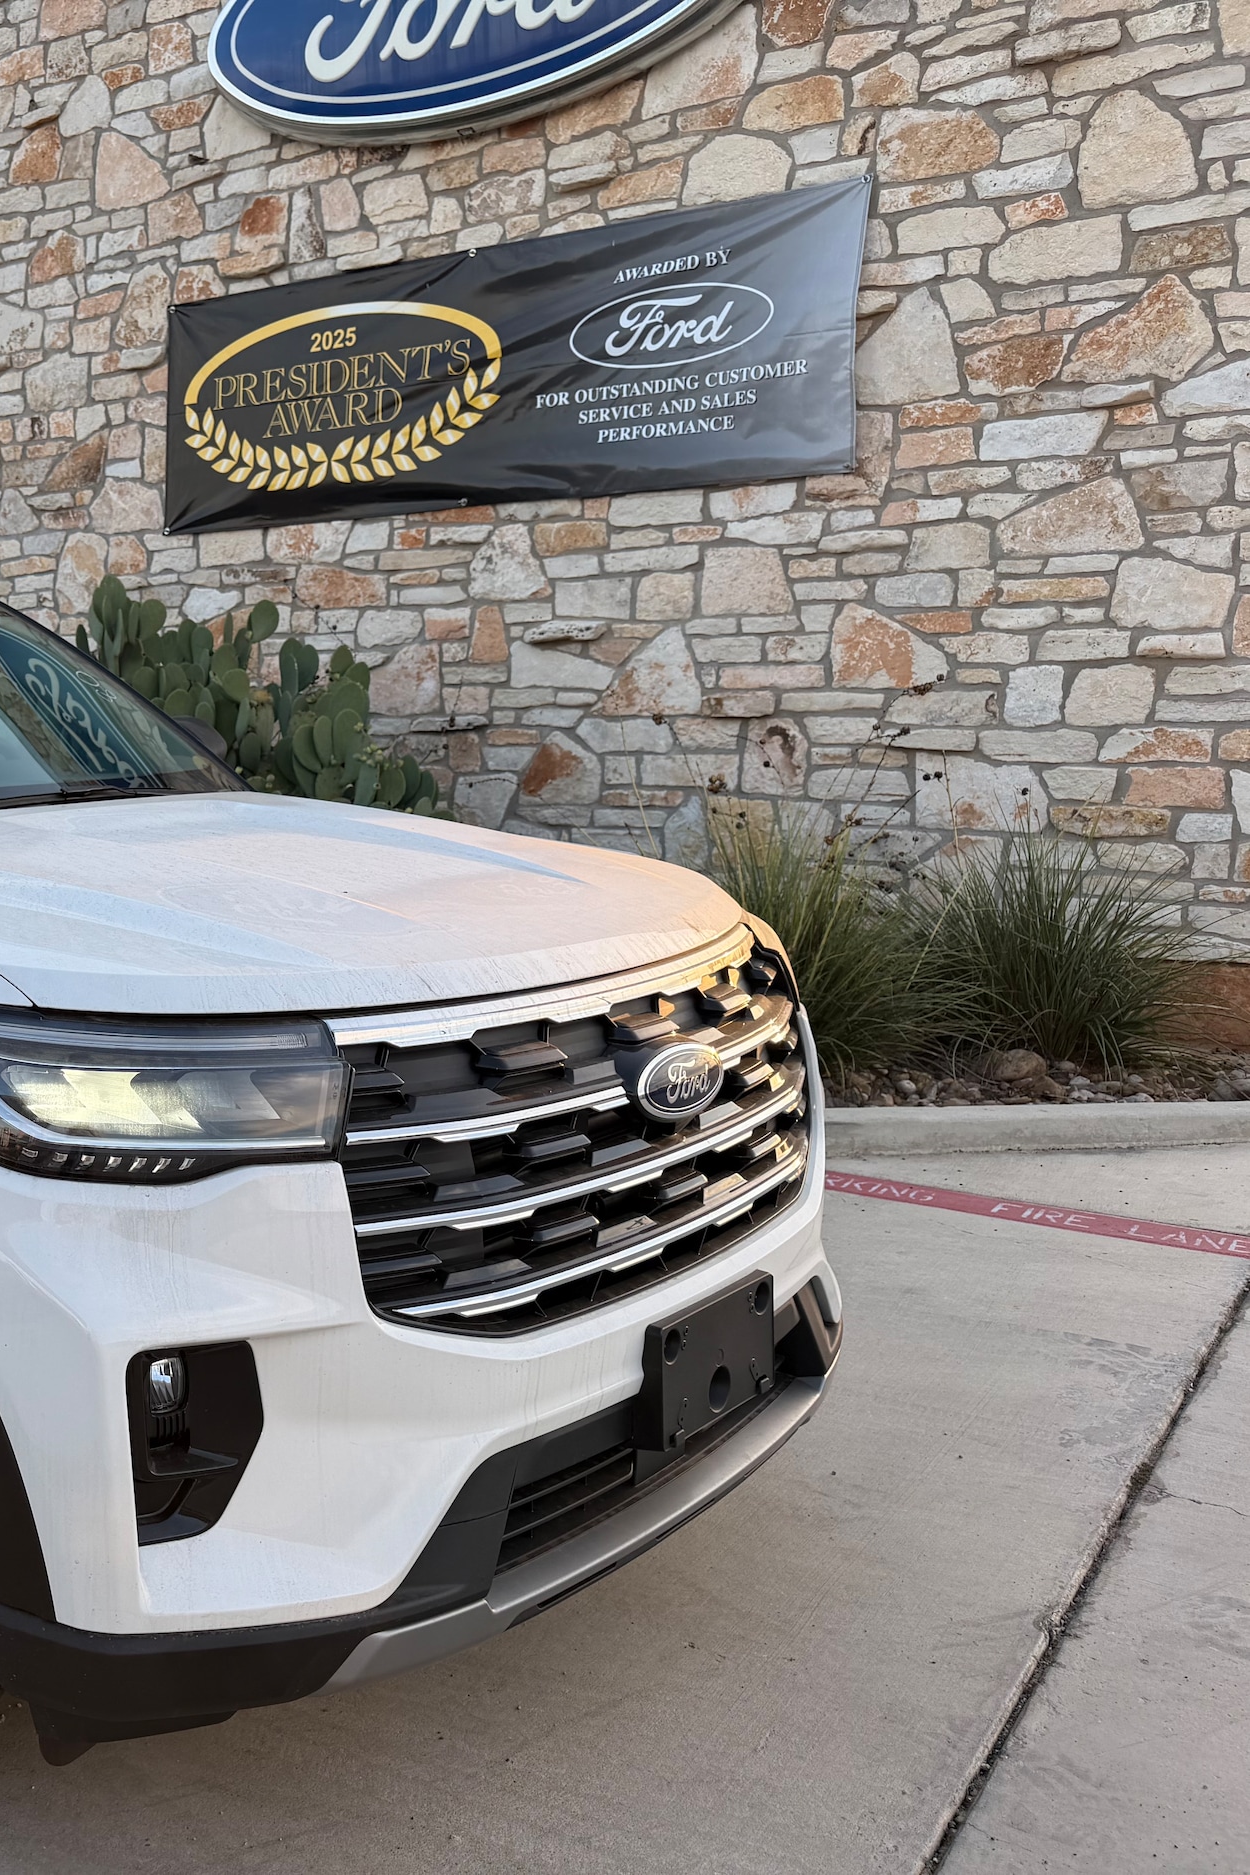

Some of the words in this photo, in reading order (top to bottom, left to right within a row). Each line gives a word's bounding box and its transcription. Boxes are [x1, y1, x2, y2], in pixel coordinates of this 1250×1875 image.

[614, 255, 699, 284] AWARDED
[705, 249, 732, 267] BY
[310, 327, 357, 352] 2025
[605, 294, 735, 357] Ford
[213, 339, 471, 411] PRESIDENT'S
[535, 391, 570, 409] FOR
[575, 375, 700, 404] OUTSTANDING
[705, 359, 808, 388] CUSTOMER
[262, 387, 404, 439] AWARD
[578, 403, 653, 425] SERVICE
[658, 397, 696, 416] AND
[701, 389, 757, 411] SALES
[597, 415, 735, 443] PERFORMANCE
[666, 1058, 711, 1104] Ford
[990, 1202, 1096, 1229] FIRE
[1126, 1224, 1250, 1254] LANE
